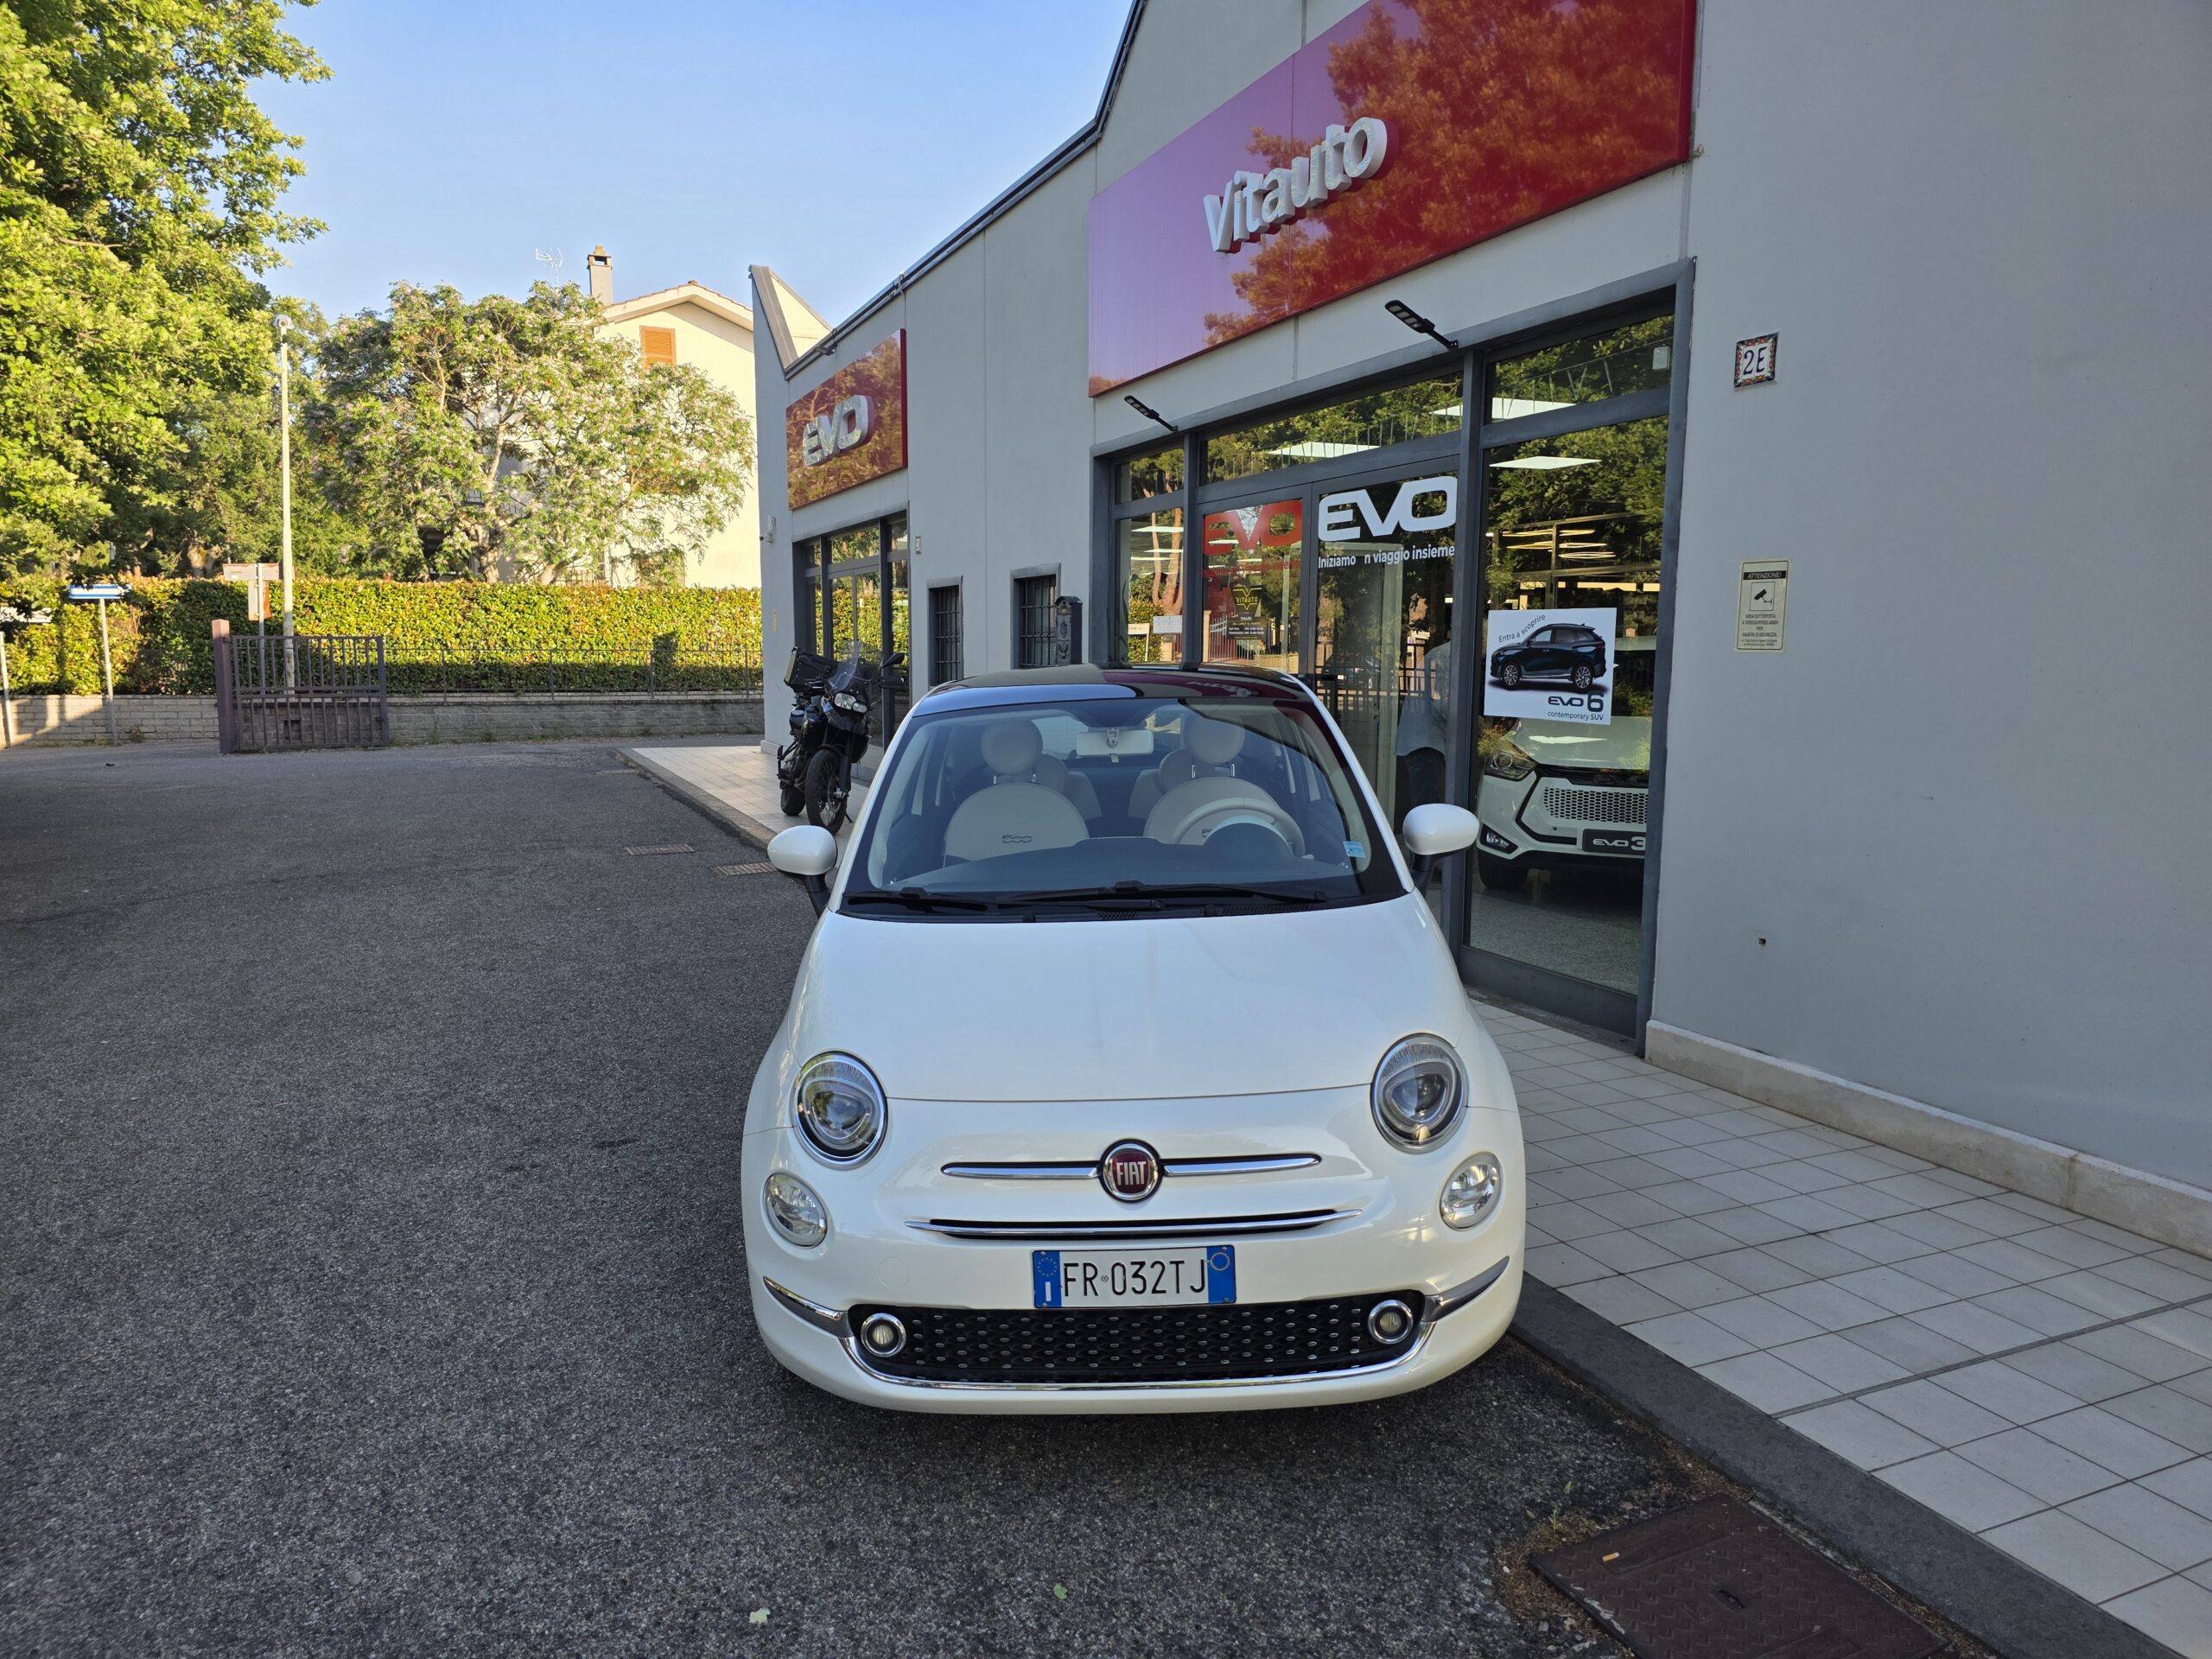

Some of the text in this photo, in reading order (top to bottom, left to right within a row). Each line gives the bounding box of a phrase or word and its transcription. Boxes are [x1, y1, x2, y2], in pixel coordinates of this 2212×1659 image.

[1203, 117, 1388, 253] Vitauto
[1743, 346, 1767, 375] 2E
[803, 394, 868, 466] EVO
[1319, 476, 1458, 542] EVO
[1204, 500, 1303, 555] EVO
[1319, 554, 1356, 569] Iniziamo
[1374, 547, 1410, 565] viaggio
[1412, 543, 1455, 560] insieme
[1498, 632, 1516, 643] Entra
[1522, 614, 1546, 635] scoprire
[1548, 691, 1605, 713] EVO 6
[1548, 711, 1590, 721] contemporary
[1592, 838, 1629, 847] EVO
[1116, 1161, 1147, 1185] FIAT
[1064, 1262, 1098, 1296] FR
[1111, 1259, 1205, 1296] 032TJ
